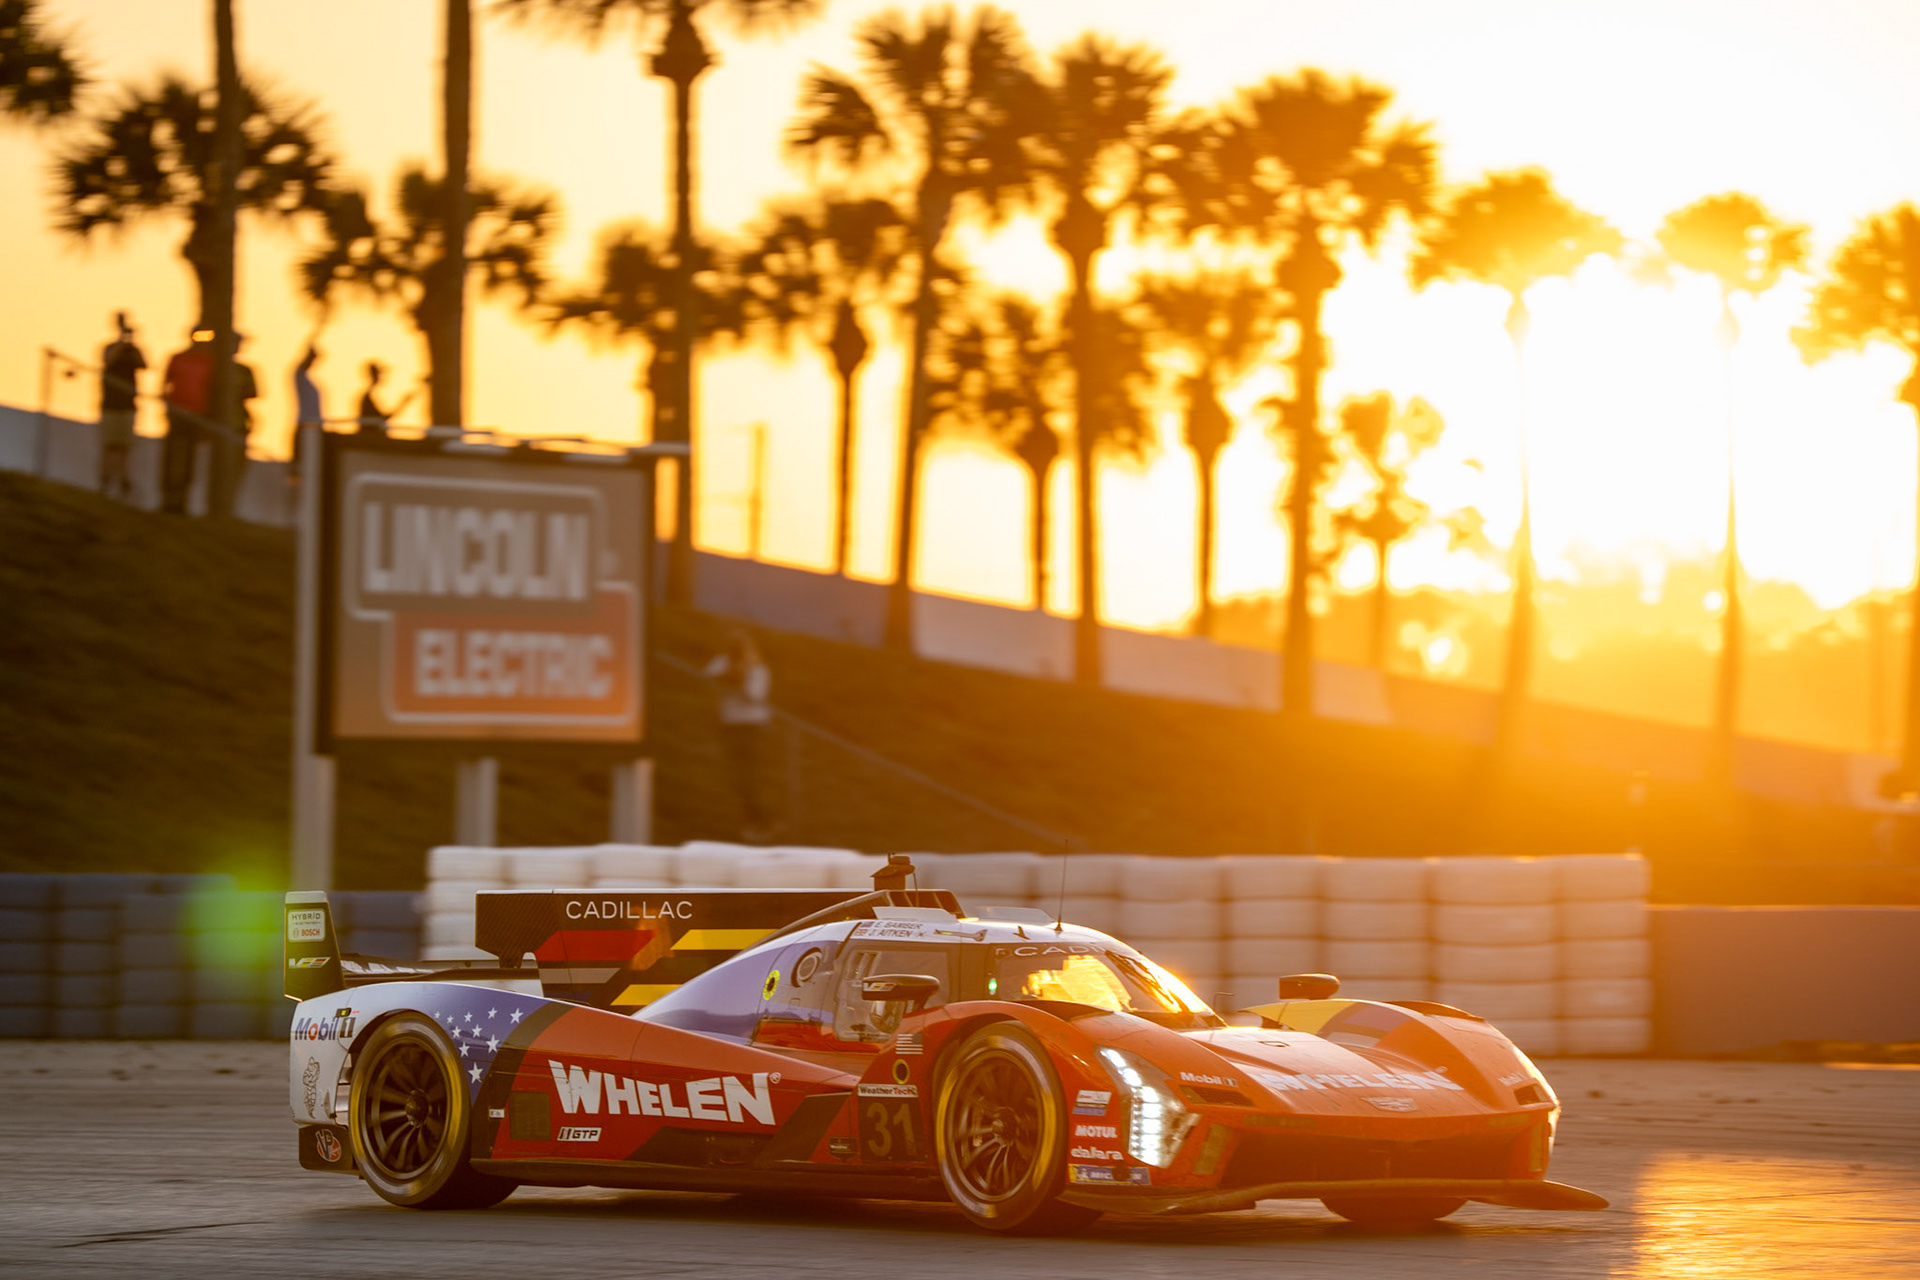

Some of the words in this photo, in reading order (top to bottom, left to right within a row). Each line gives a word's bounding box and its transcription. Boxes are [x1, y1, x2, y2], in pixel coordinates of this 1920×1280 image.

[363, 502, 590, 599] LINCOLN
[414, 628, 613, 698] ELECTRIC
[291, 912, 321, 921] HYBRID
[565, 900, 692, 919] CADILLAC
[301, 928, 320, 937] BOSCH
[879, 929, 912, 937] AITKEN
[295, 1017, 339, 1040] Mobil
[1180, 1071, 1222, 1085] Mobil
[548, 1059, 776, 1125] WHELEN
[867, 1103, 917, 1156] 31
[1075, 1125, 1117, 1138] MOTUL
